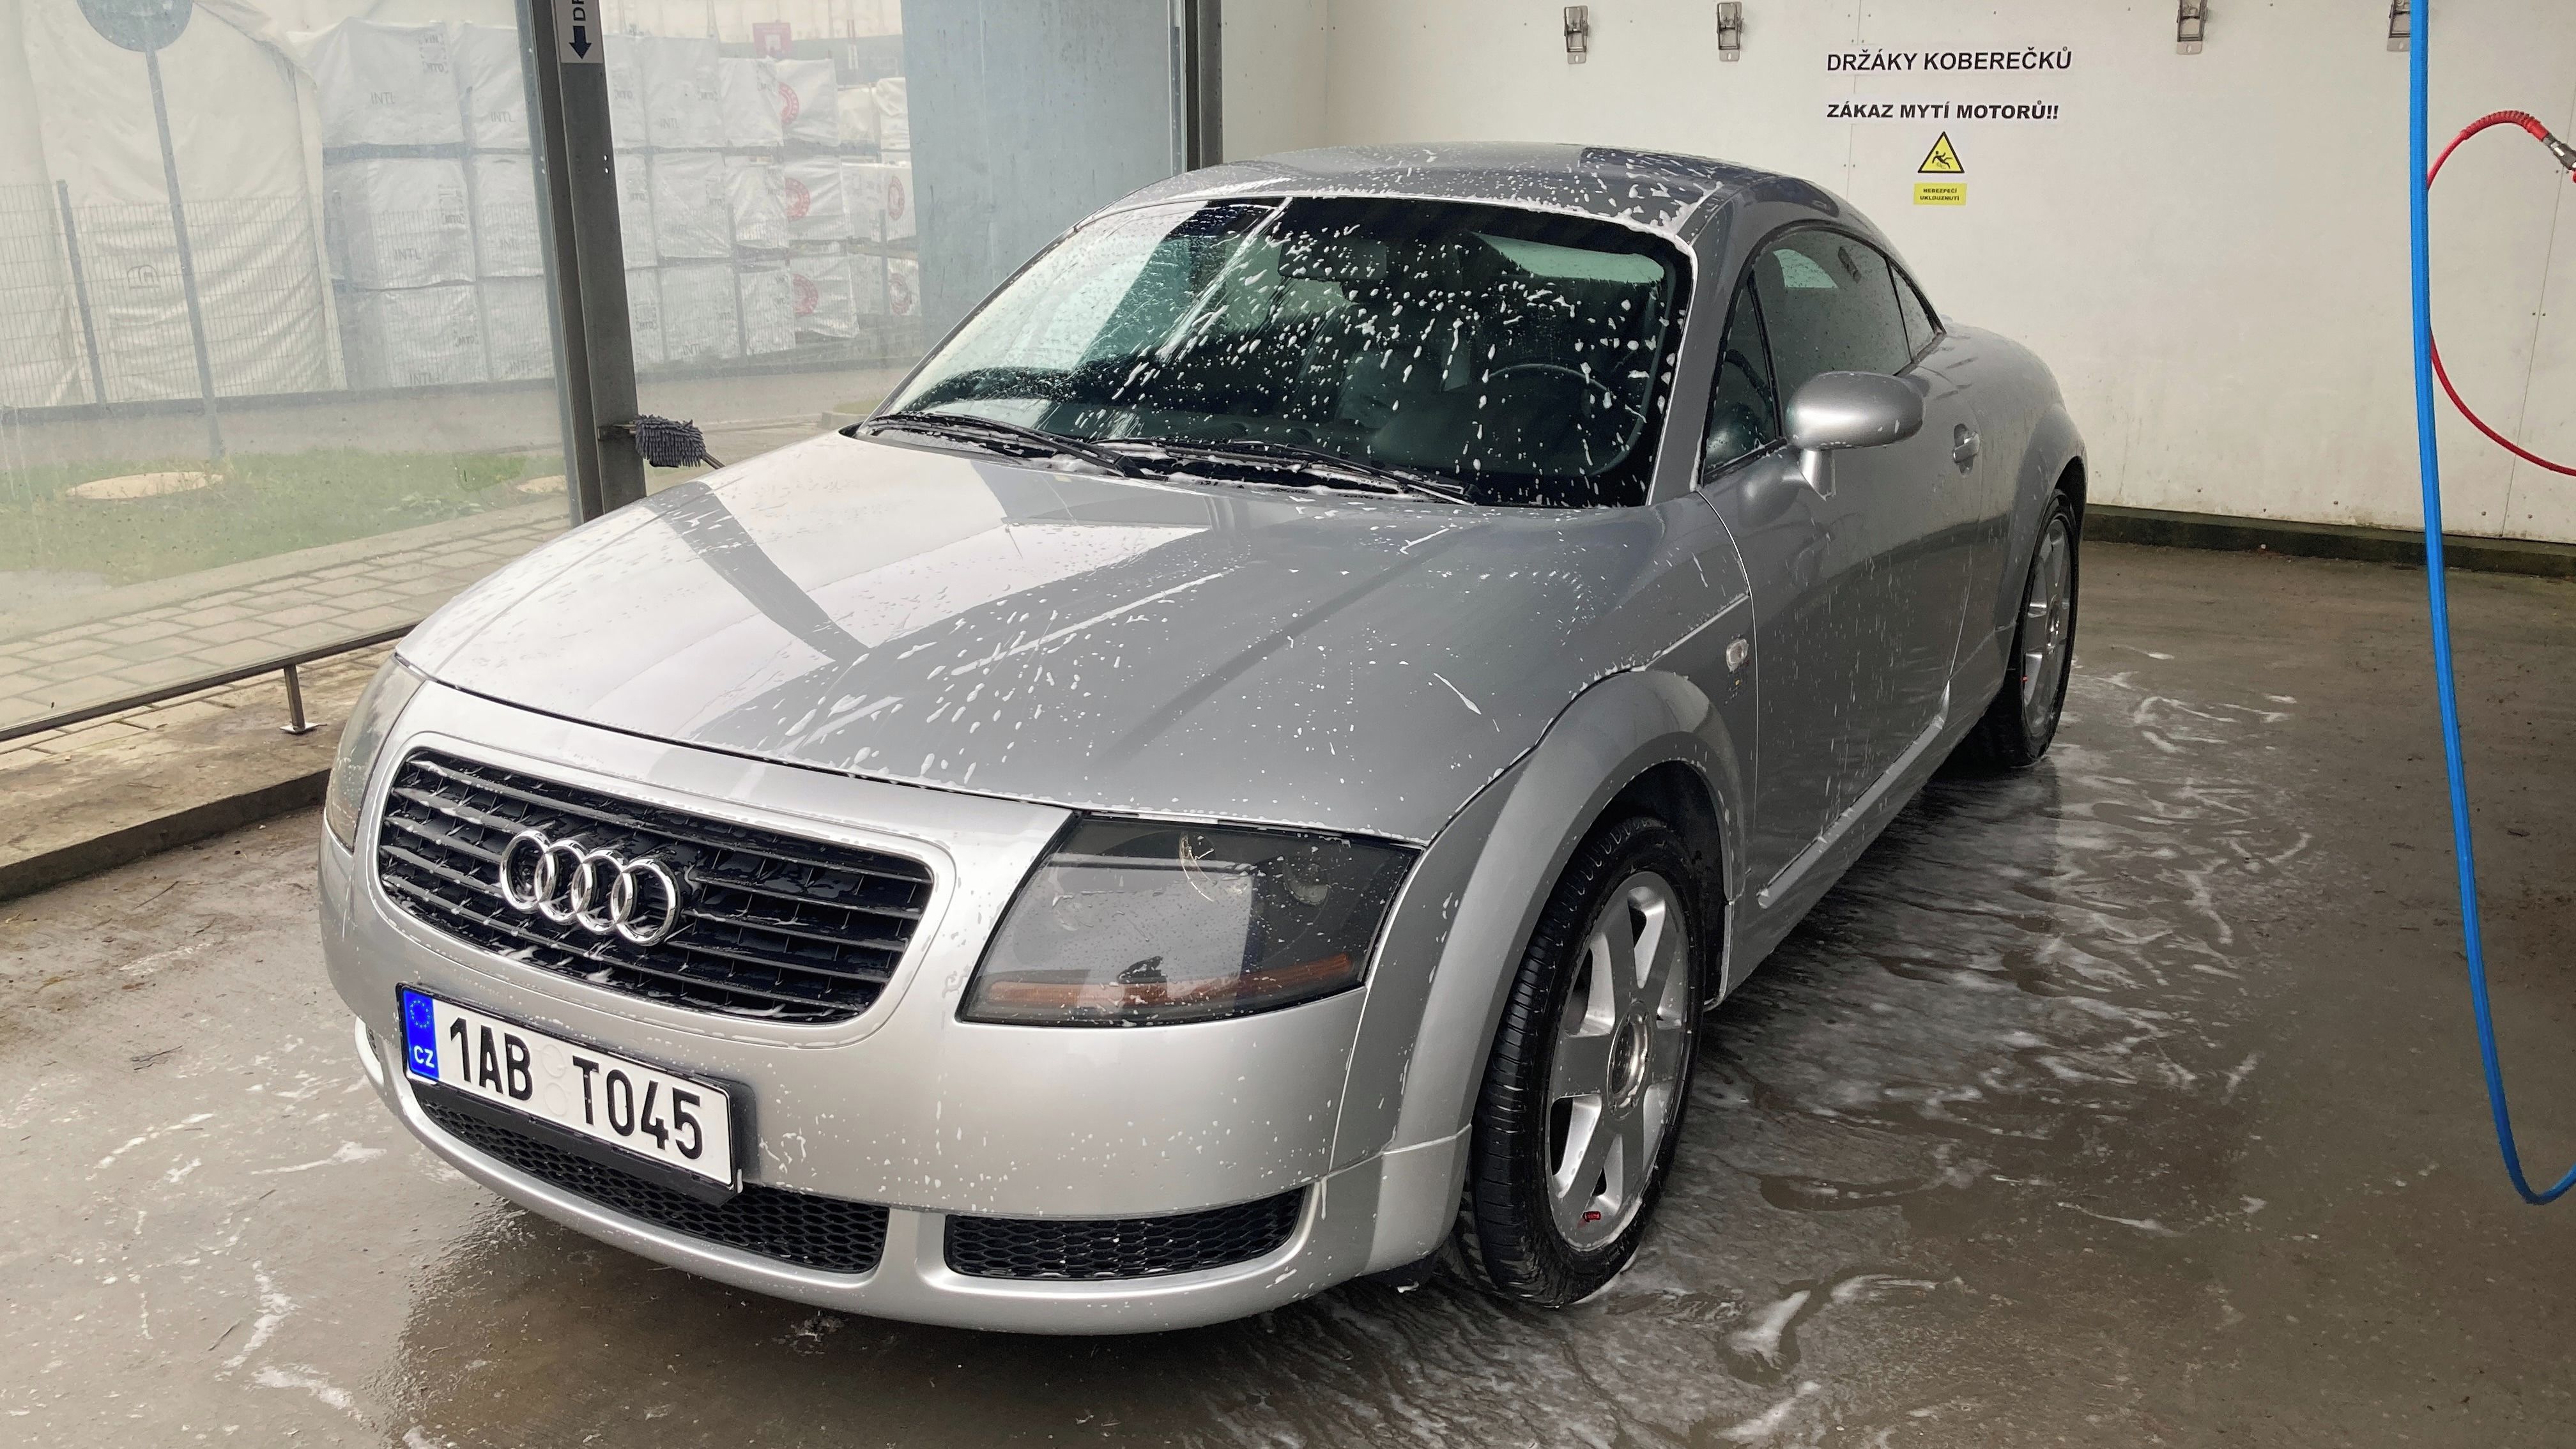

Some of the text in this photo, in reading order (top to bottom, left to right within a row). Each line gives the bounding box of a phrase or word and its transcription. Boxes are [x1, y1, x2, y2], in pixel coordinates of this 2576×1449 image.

[1827, 46, 2072, 70] DRŽÁKY KOBEREČKŮ
[1827, 100, 2059, 119] ZÁKAZ MYTÍ MOTORŮ!!
[414, 1045, 435, 1068] CZ
[450, 1017, 703, 1160] 1AB T045
